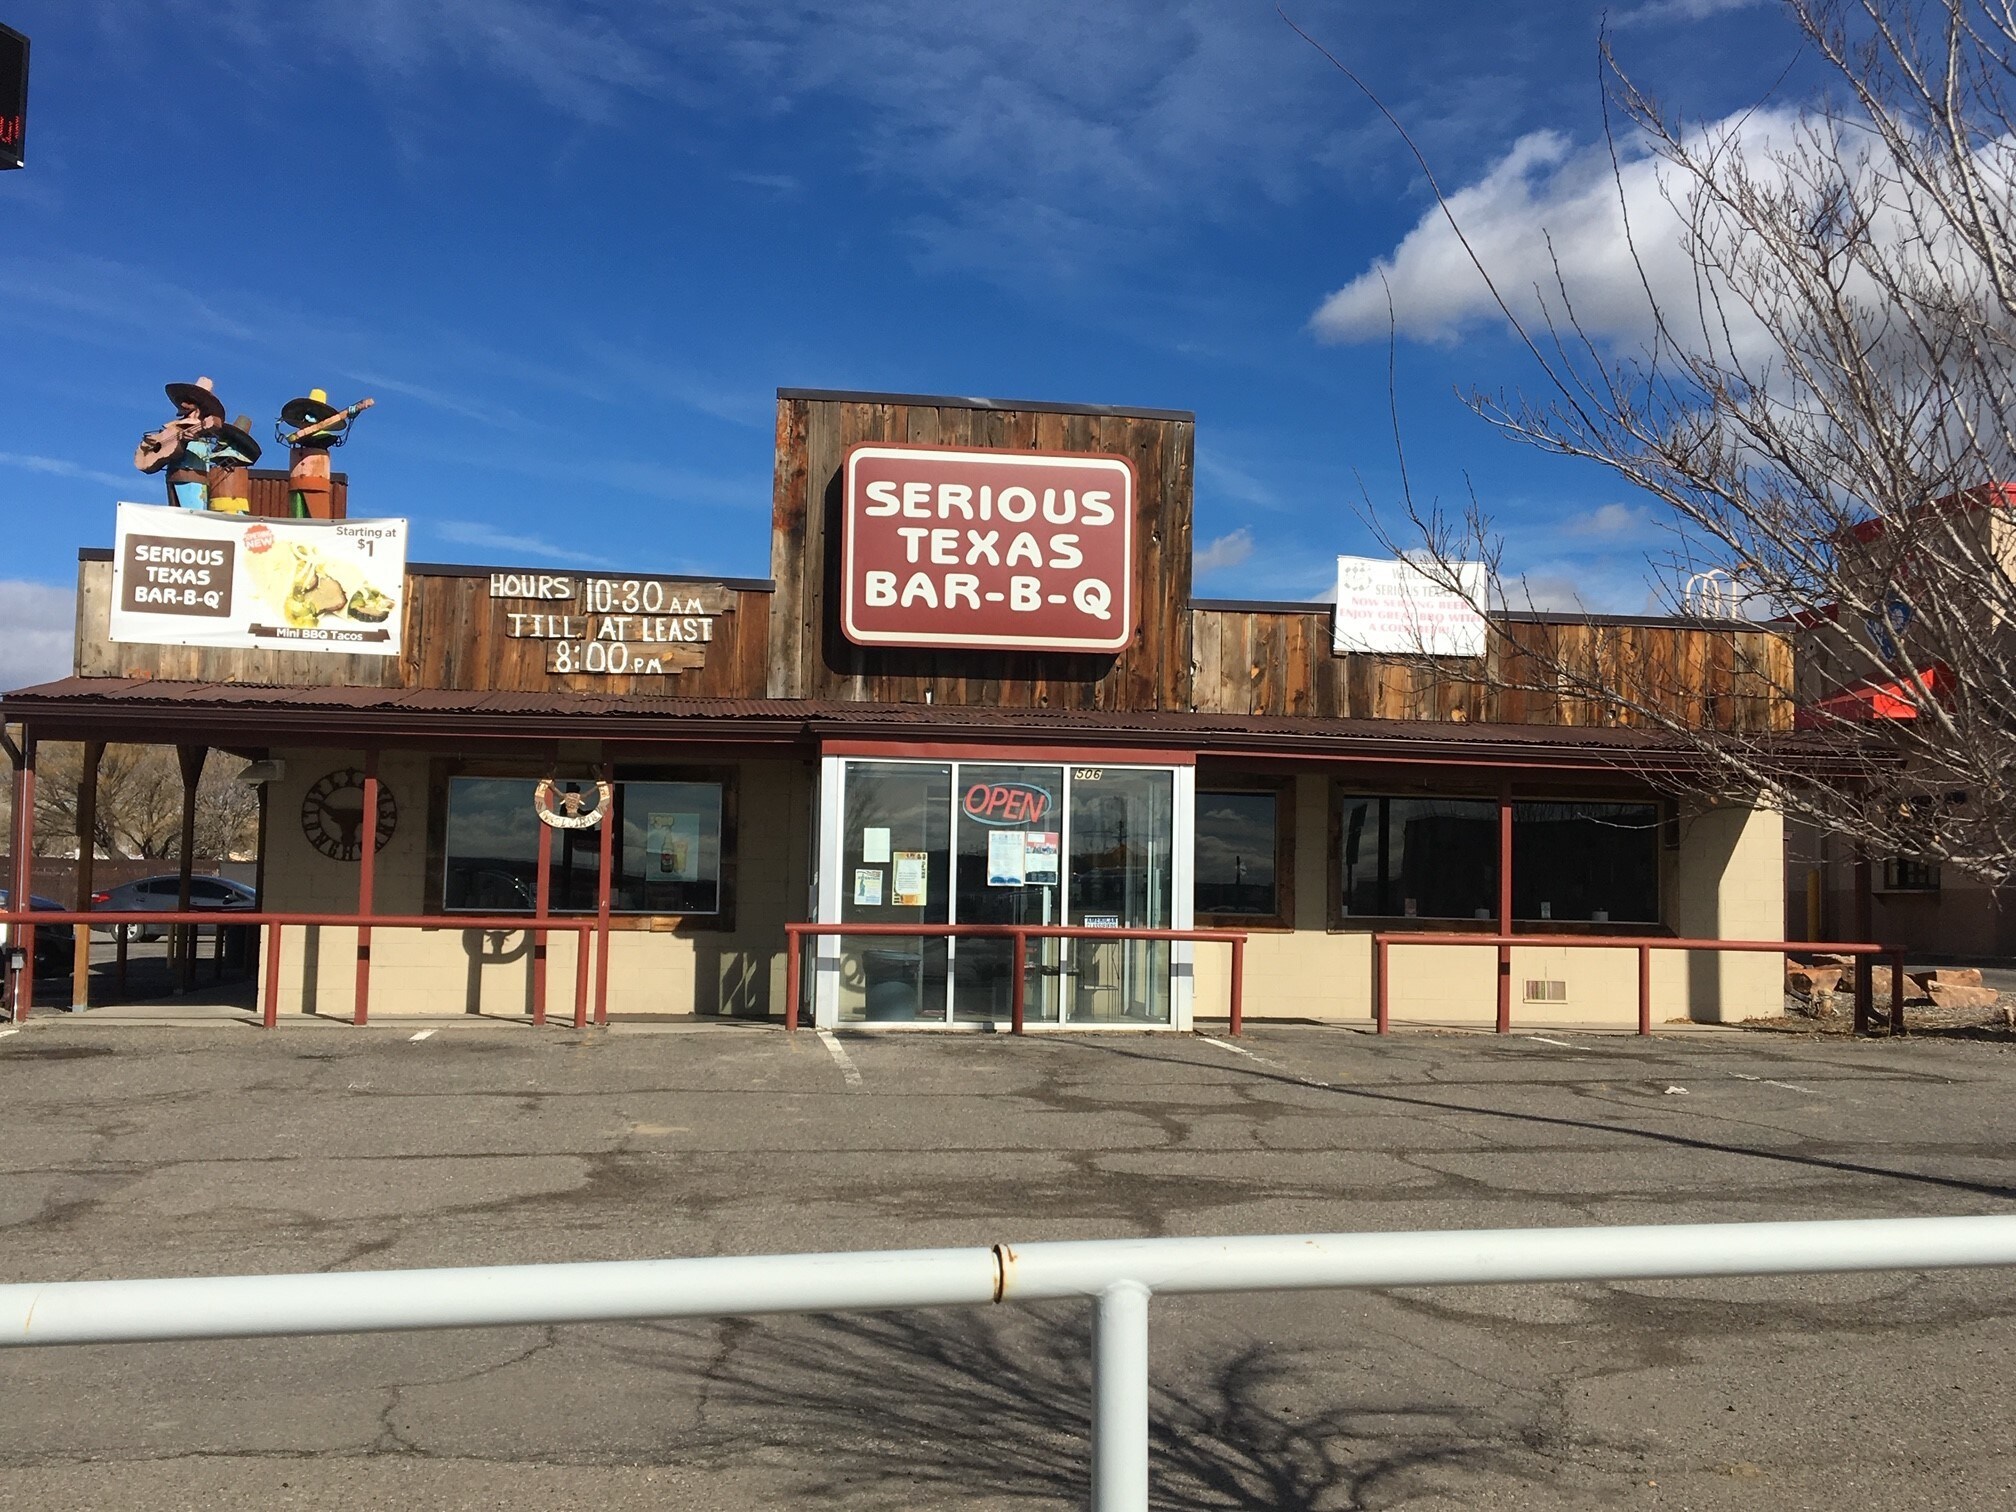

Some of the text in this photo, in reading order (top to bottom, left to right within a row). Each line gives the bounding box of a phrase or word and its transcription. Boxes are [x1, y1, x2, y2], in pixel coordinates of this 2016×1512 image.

[865, 481, 1115, 526] SERIOUS
[336, 526, 396, 538] Starting at
[245, 536, 273, 551] NEW
[357, 539, 374, 557] $1
[897, 527, 1084, 569] TEXAS
[135, 545, 224, 566] SERIOUS
[145, 566, 211, 585] TEXAS
[490, 573, 704, 614] HOURS 10:30 AM
[865, 571, 1112, 620] BAR-B-Q
[1352, 597, 1378, 607] NOW
[1438, 601, 1470, 610] BEER
[1340, 607, 1374, 620] ENJOY
[1420, 613, 1445, 624] BBQ
[1449, 614, 1482, 623] WITH
[276, 628, 363, 641] Mini BBQ Tacos
[507, 613, 713, 642] TILL AT LEAST
[1369, 623, 1377, 632] A
[556, 640, 663, 674] 8:00 PM
[1076, 769, 1101, 779] 506
[965, 784, 1047, 823] OPEN
